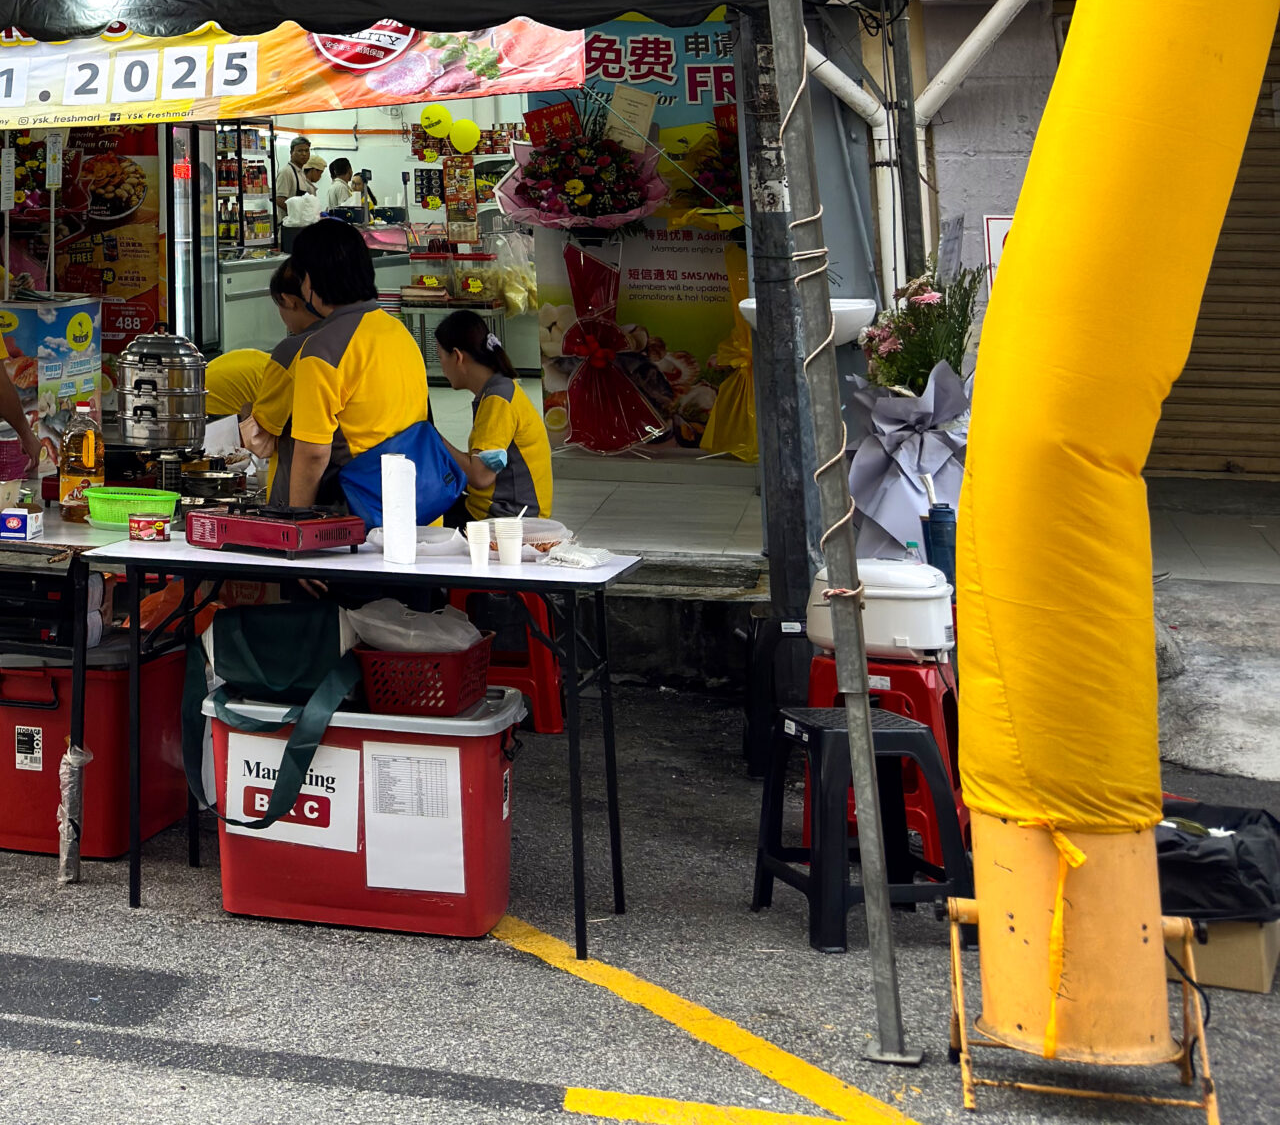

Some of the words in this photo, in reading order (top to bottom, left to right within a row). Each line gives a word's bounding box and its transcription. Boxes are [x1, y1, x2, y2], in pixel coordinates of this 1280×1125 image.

[585, 34, 676, 84] 免费
[684, 31, 735, 59] 申请
[686, 65, 737, 103] FR
[127, 112, 143, 120] YSK
[147, 109, 195, 119] Freshmart
[71, 253, 94, 264] FREE
[628, 268, 678, 281] 短信通知
[628, 283, 667, 291] Members
[668, 283, 681, 291] will
[682, 283, 694, 292] be
[115, 316, 141, 330] 488
[33, 733, 42, 755] BOX
[242, 759, 337, 794] Maring
[254, 793, 269, 812] B
[303, 800, 320, 819] C
